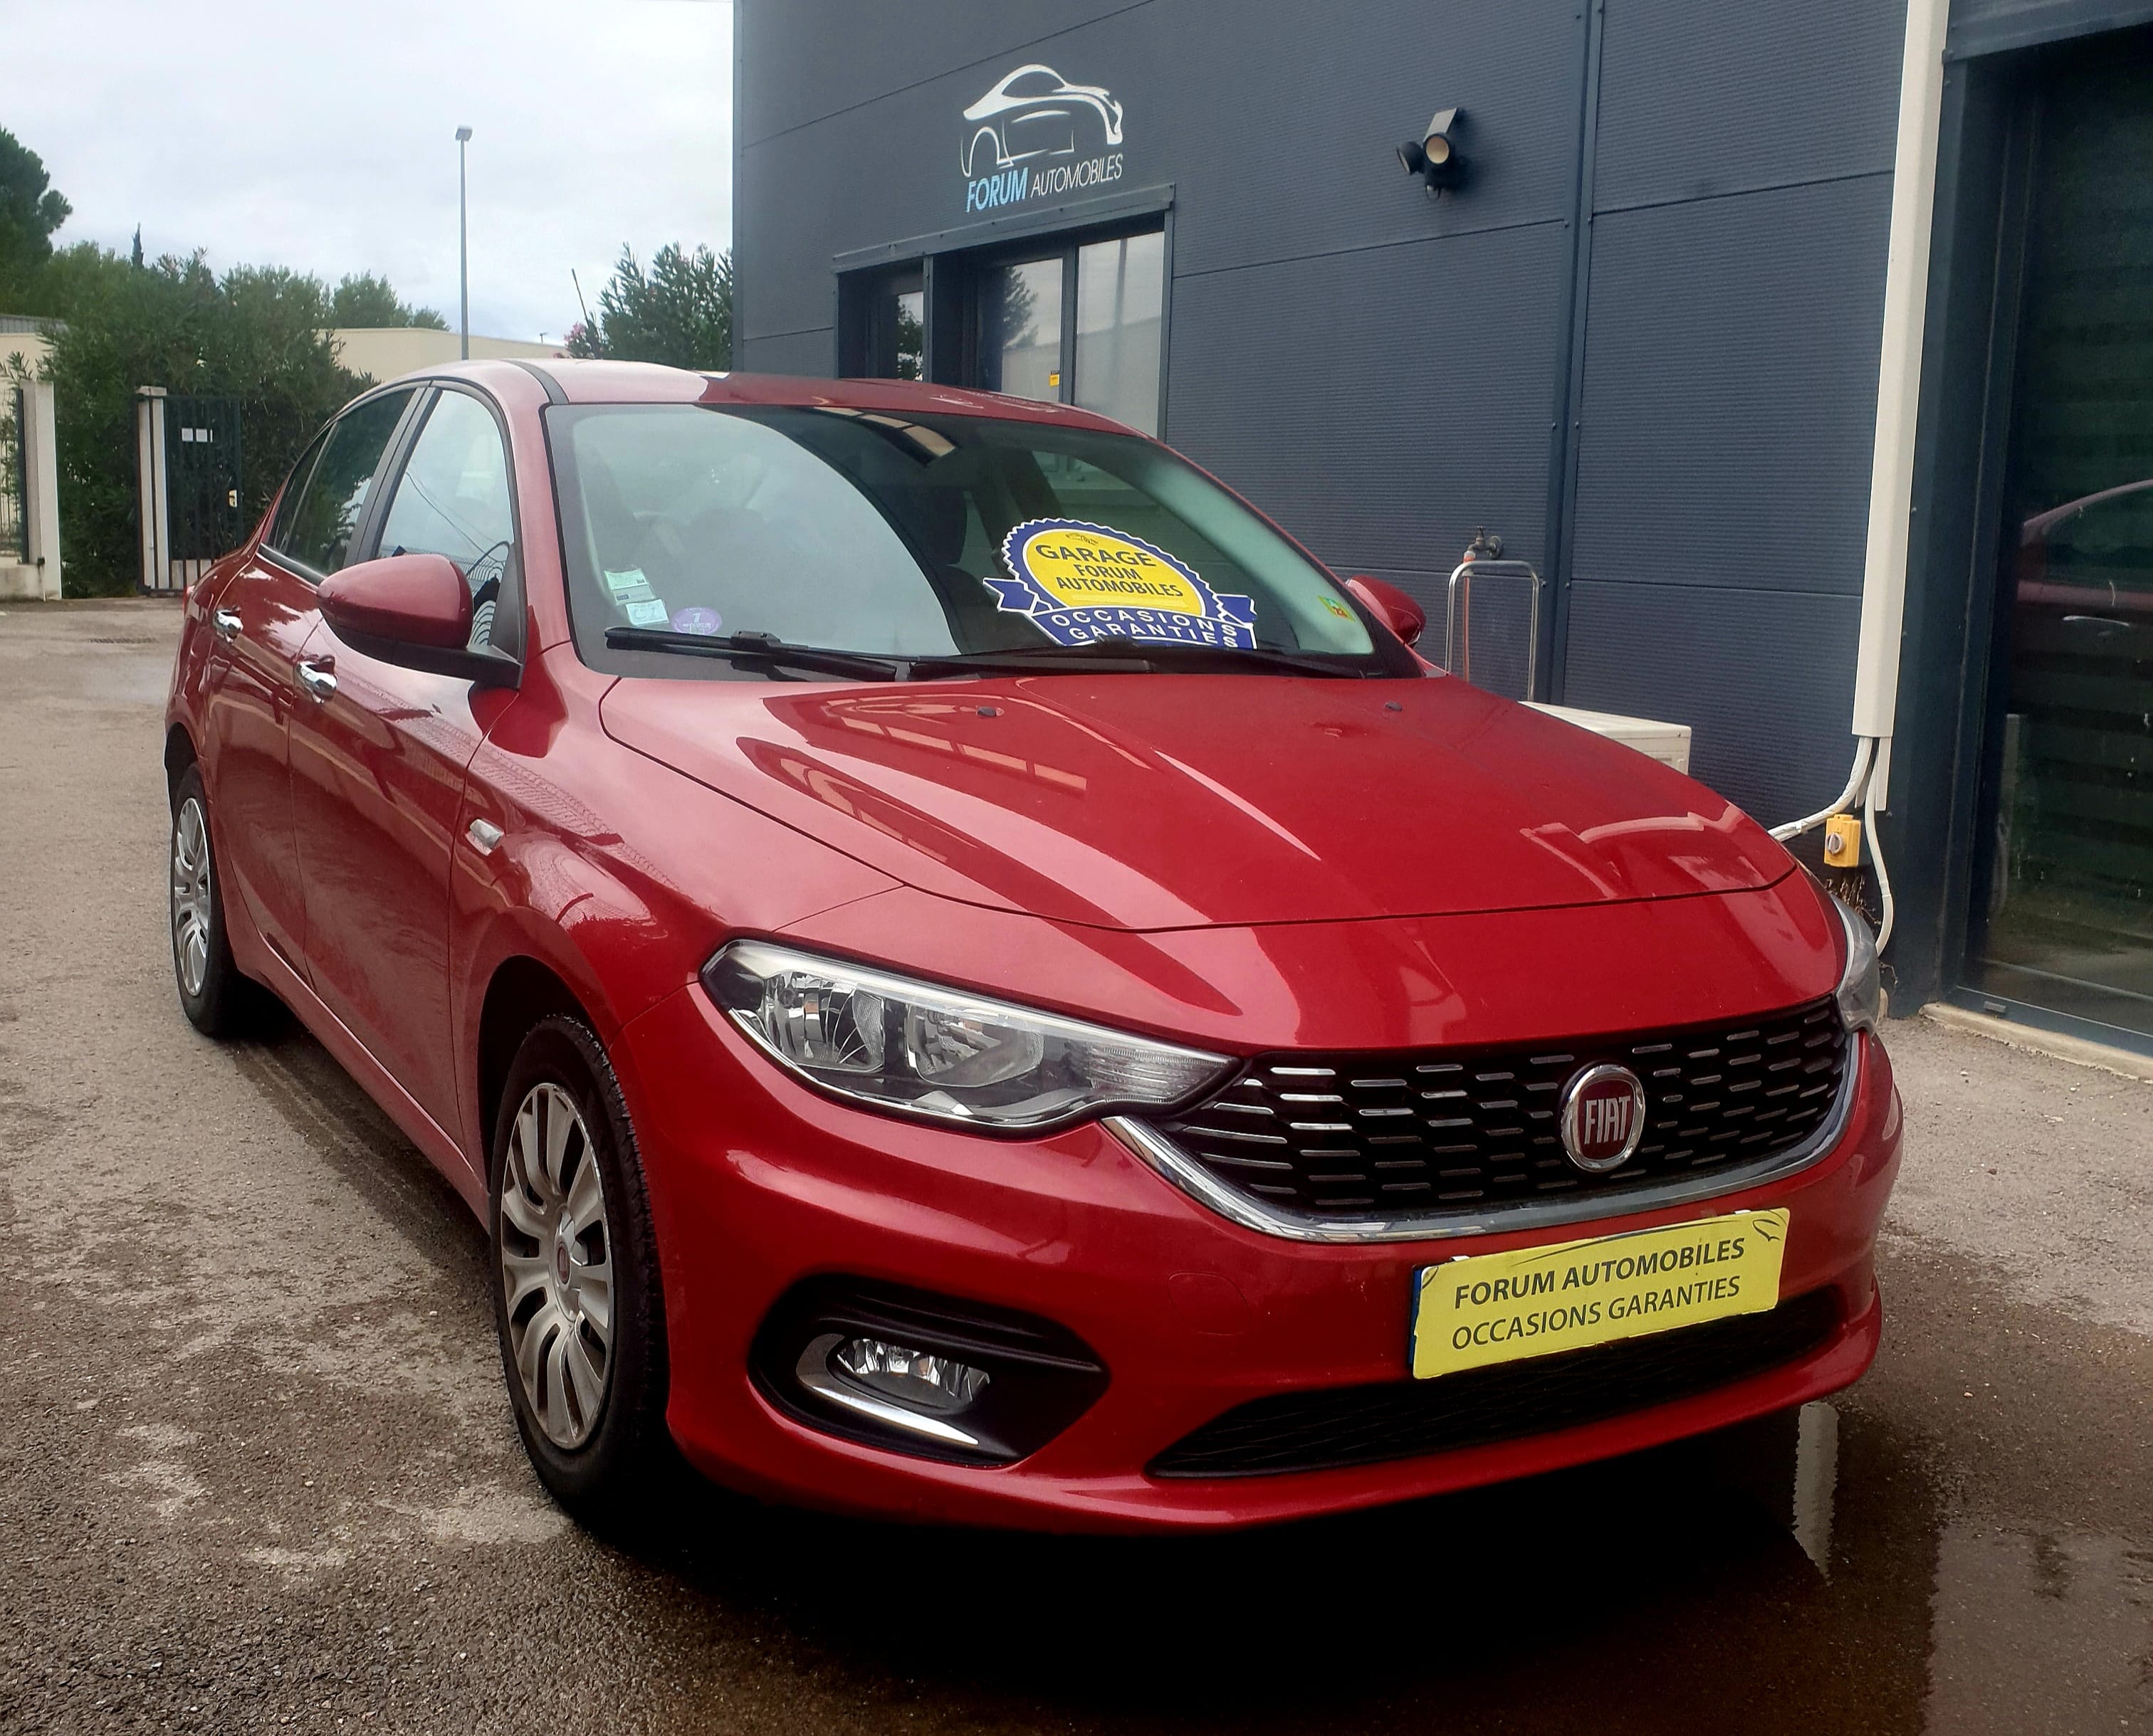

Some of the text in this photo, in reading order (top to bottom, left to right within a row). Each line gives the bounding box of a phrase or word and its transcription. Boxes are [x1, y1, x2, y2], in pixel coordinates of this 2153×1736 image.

[966, 153, 1123, 213] FORUM AUTOMOBILES
[1036, 545, 1156, 567] GARAGE
[1074, 564, 1143, 580] FORUM
[1055, 577, 1184, 598] AUTOMOBILES
[1051, 609, 1238, 637] OCCASIONS
[1068, 623, 1239, 648] GARANTIES
[1584, 1095, 1631, 1145] FIAT
[1455, 1237, 1746, 1309] FORUM AUTOMOBILES
[1452, 1275, 1741, 1350] OCCASIONS GARANTIES
